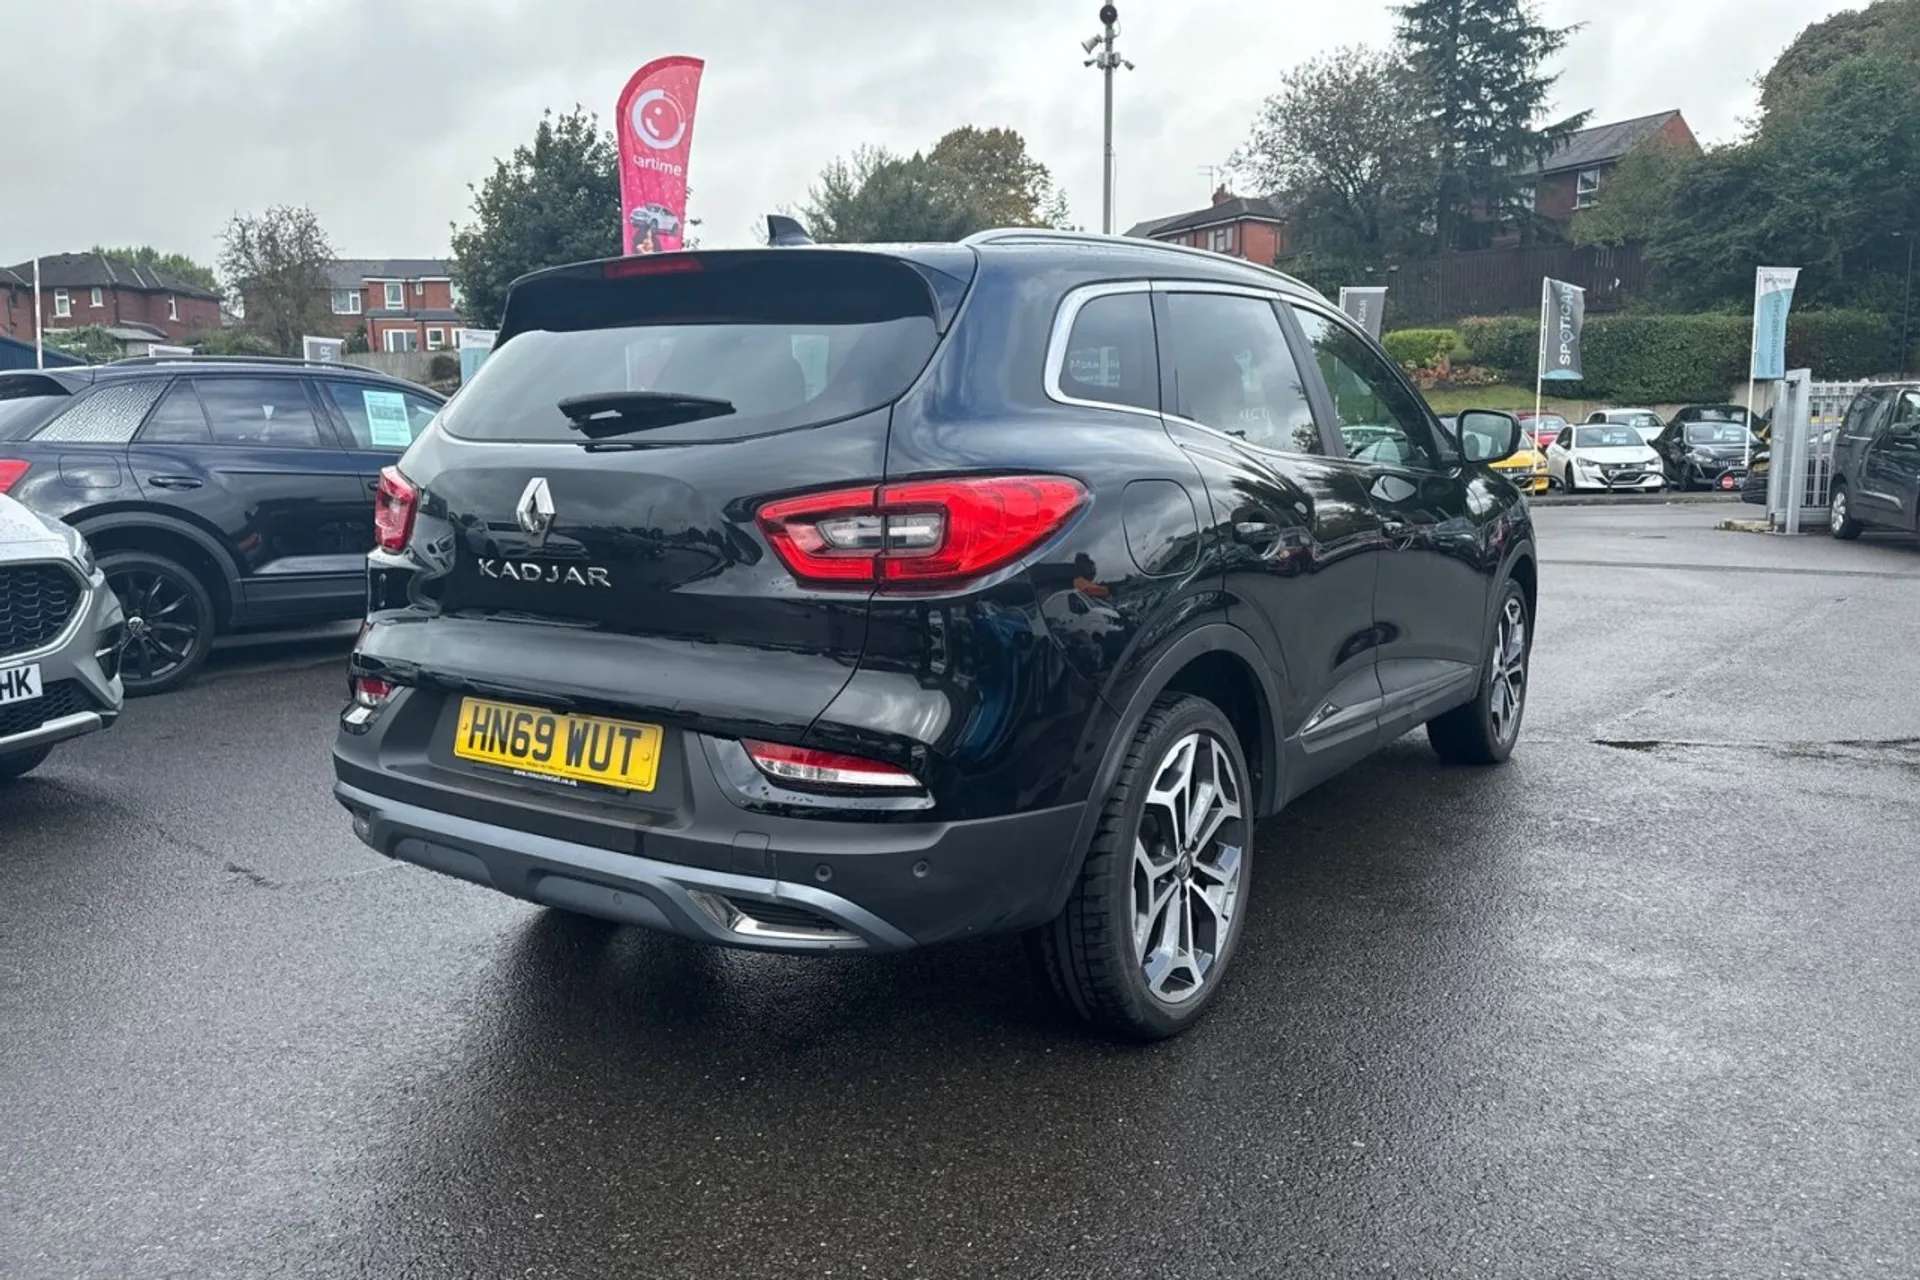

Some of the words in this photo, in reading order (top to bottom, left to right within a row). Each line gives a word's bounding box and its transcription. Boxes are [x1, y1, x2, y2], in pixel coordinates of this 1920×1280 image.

[633, 155, 682, 177] cartime
[478, 558, 612, 588] KADJAR
[468, 705, 556, 762] HN69
[566, 719, 642, 776] WUT
